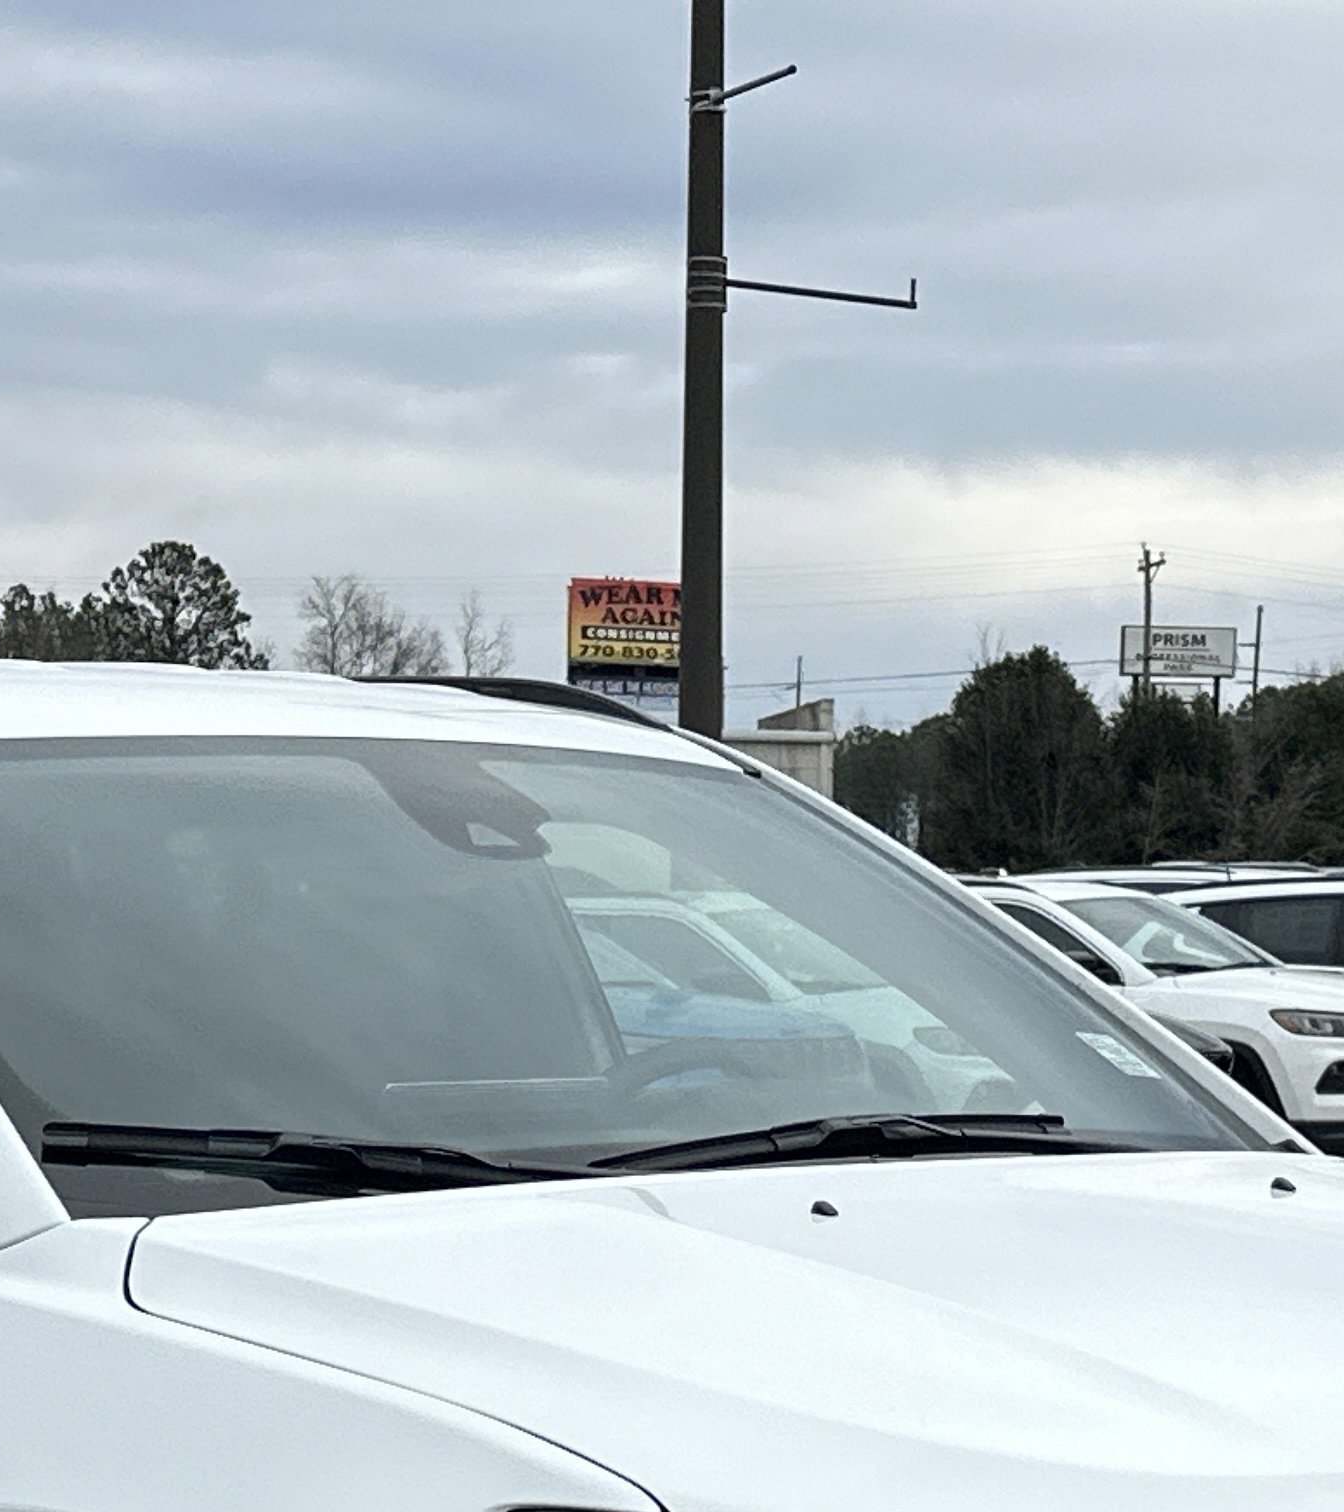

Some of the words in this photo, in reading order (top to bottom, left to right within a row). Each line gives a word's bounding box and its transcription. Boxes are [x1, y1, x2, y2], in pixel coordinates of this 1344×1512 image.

[578, 585, 664, 608] WEAR
[601, 607, 681, 626] AGAIN
[586, 627, 681, 641] CONSIGNME
[1152, 633, 1207, 647] PRISM
[578, 644, 676, 660] 770-830-5
